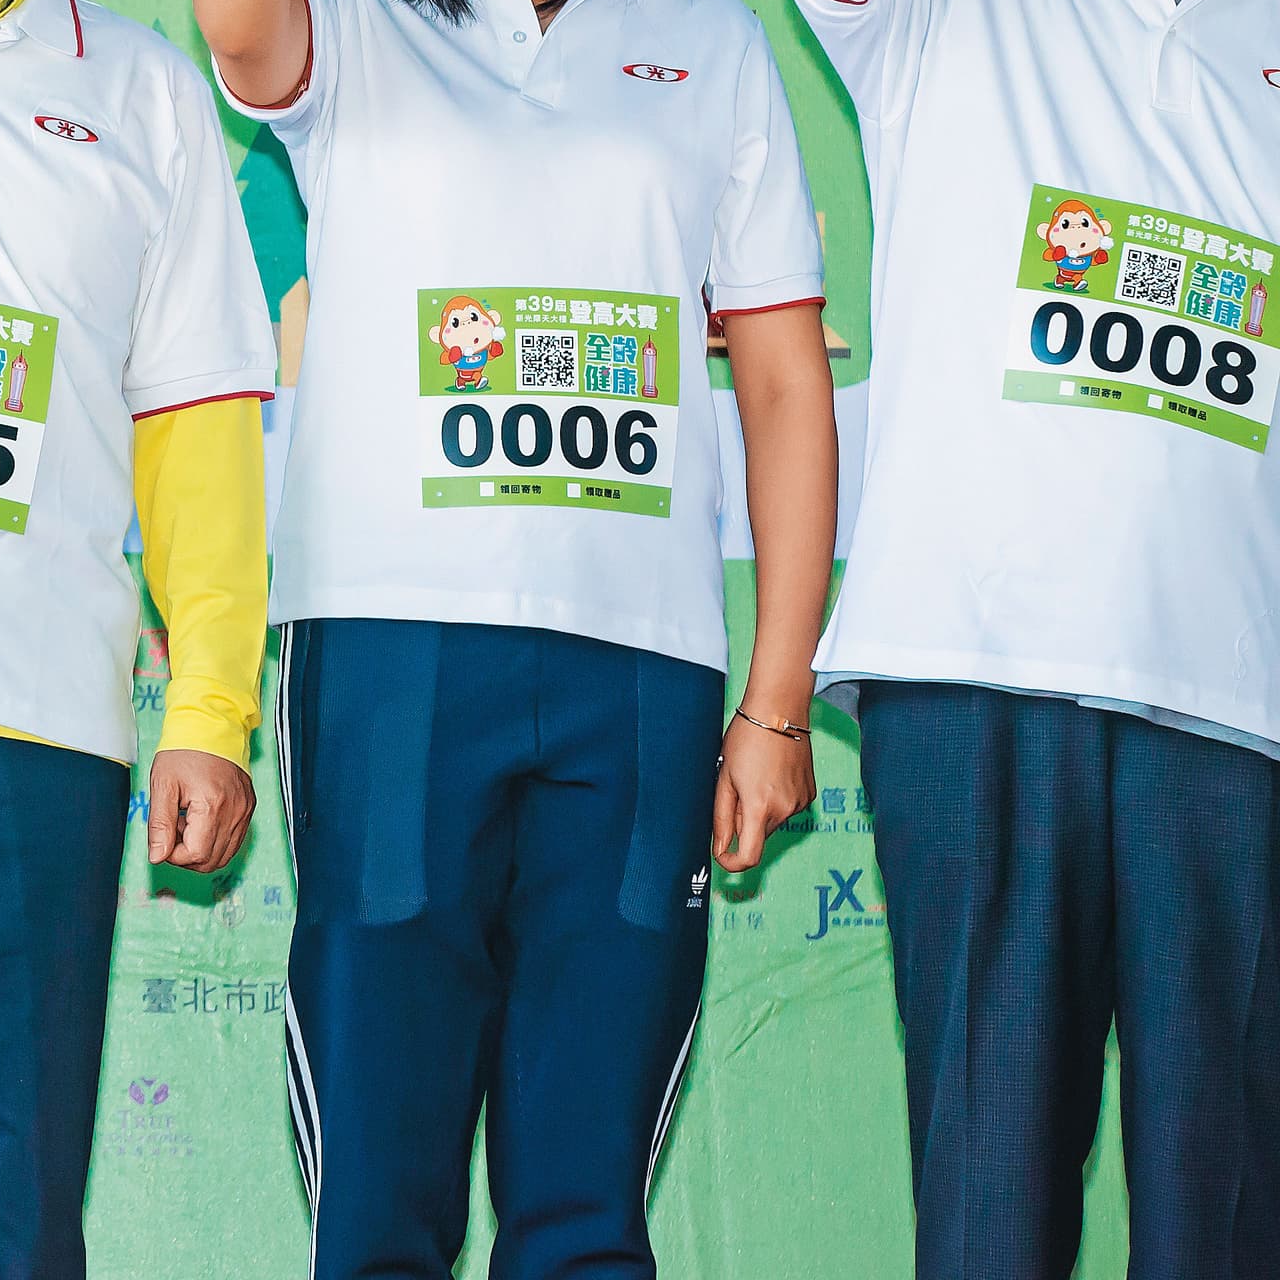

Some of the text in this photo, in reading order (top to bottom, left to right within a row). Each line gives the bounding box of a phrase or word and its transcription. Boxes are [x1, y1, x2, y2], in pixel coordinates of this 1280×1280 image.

[1180, 225, 1274, 275] 登高大賽
[1190, 261, 1248, 302] 全齡
[569, 299, 658, 330] 登高大賽
[1183, 290, 1243, 332] 健康
[585, 332, 638, 366] 全齡
[1030, 301, 1257, 406] 0008
[584, 363, 638, 397] 健康
[441, 403, 658, 475] 0006
[142, 978, 287, 1014] 臺北市政
